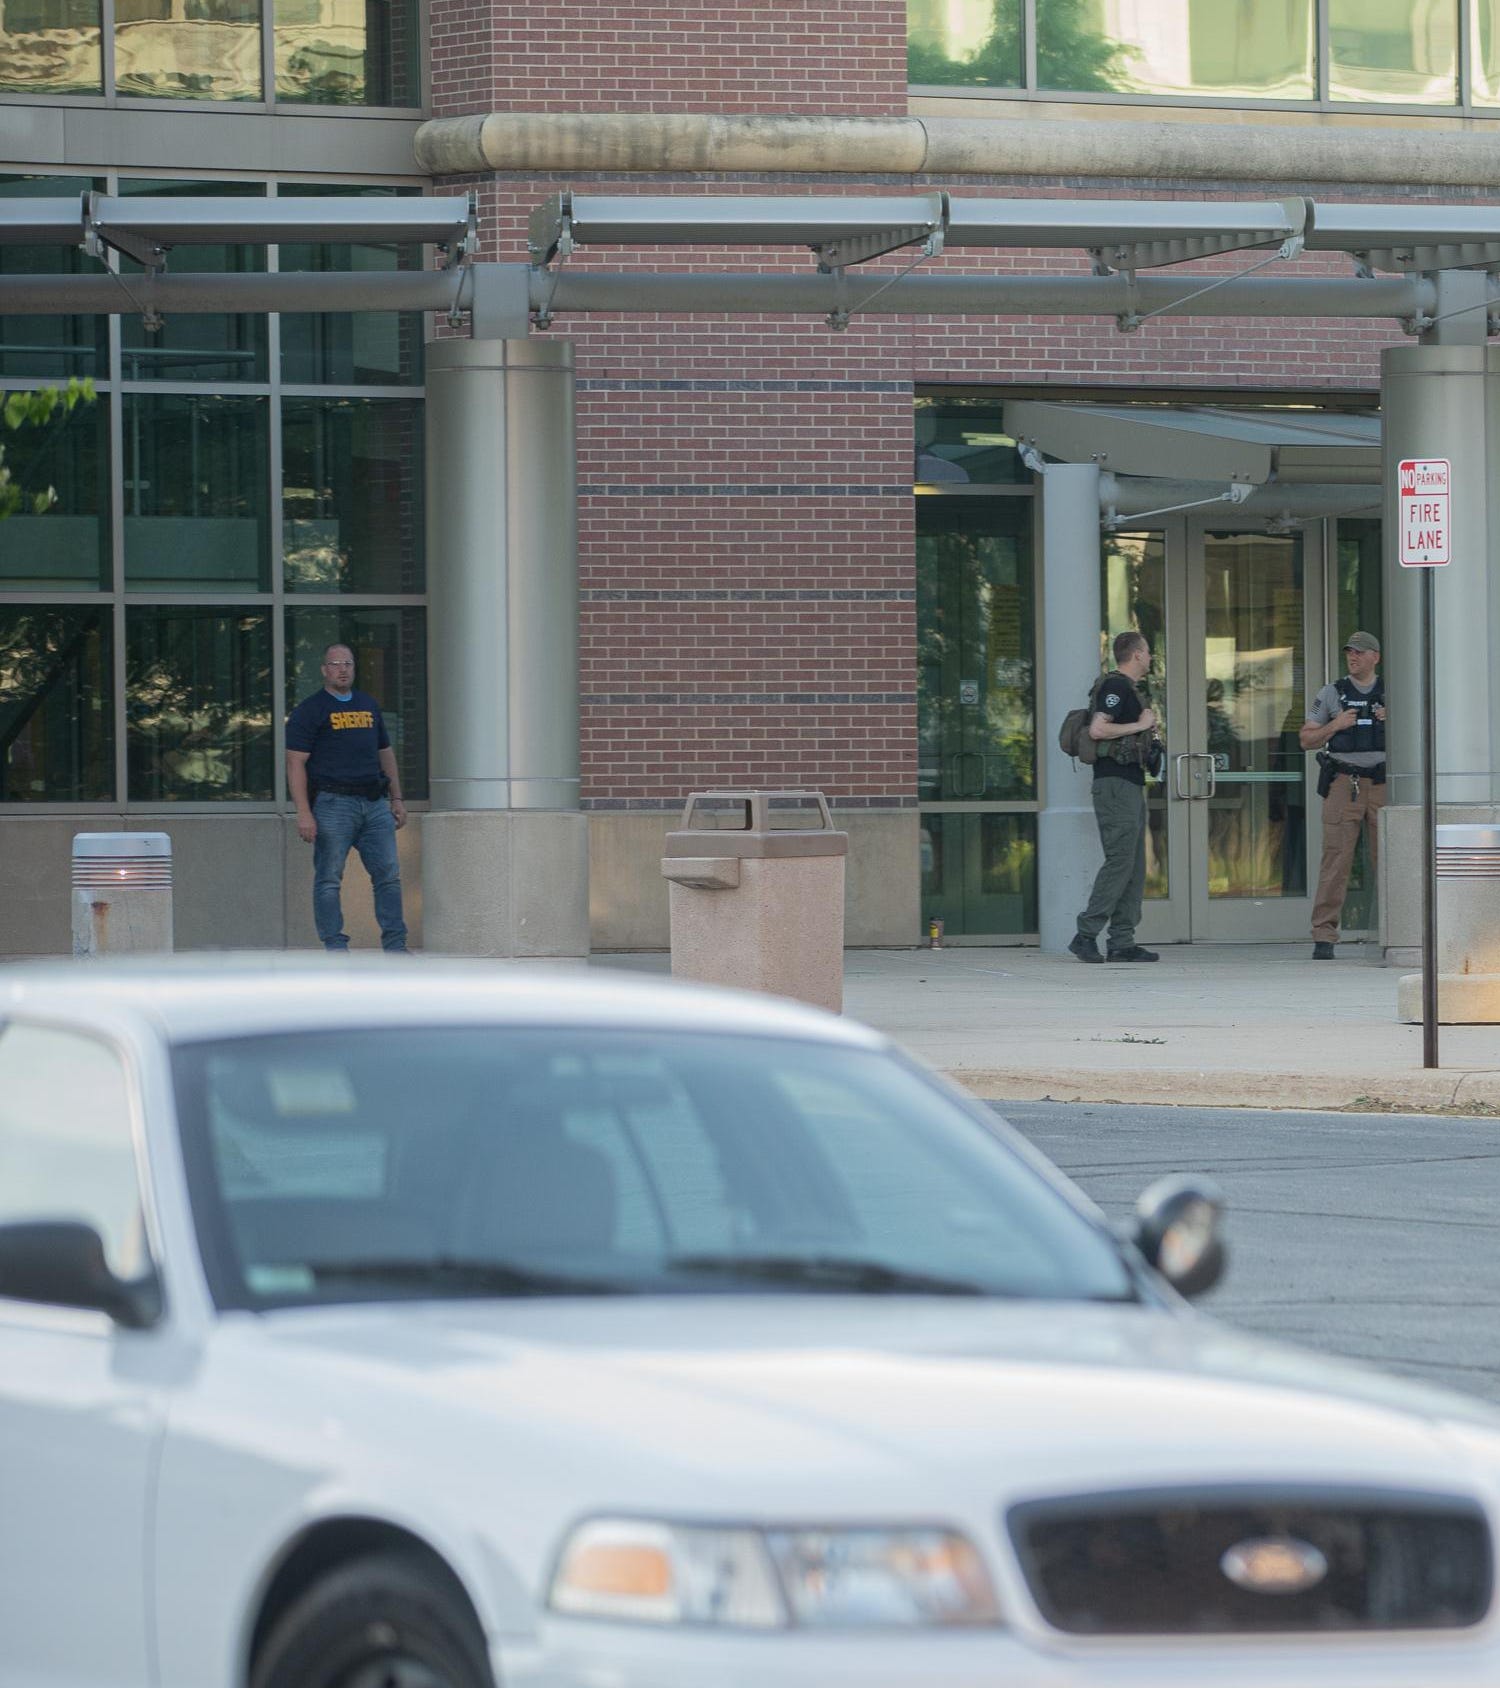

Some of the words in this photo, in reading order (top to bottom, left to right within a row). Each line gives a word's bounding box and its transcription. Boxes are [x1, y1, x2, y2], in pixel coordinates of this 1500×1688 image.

[1401, 469, 1415, 489] NO
[1416, 472, 1446, 485] PARKING
[1410, 503, 1440, 523] FIRE
[1408, 530, 1443, 549] LANE
[330, 711, 374, 730] SHERIFF
